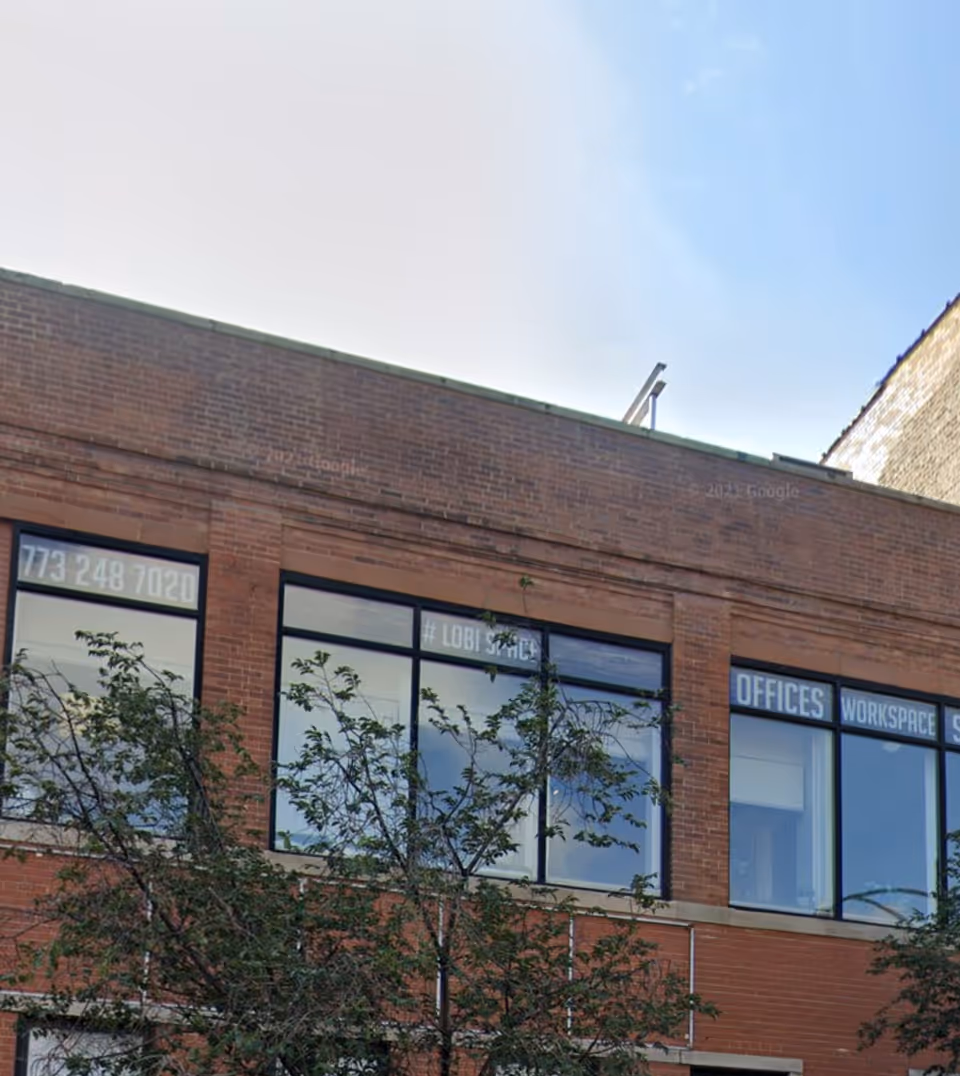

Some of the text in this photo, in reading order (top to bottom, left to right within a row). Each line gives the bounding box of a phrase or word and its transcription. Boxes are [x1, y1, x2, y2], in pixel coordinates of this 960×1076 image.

[21, 544, 196, 603] 773 248 7020
[442, 622, 480, 653] LOBI
[736, 673, 824, 720] OFFICES
[841, 696, 936, 737] WORKSPACE
